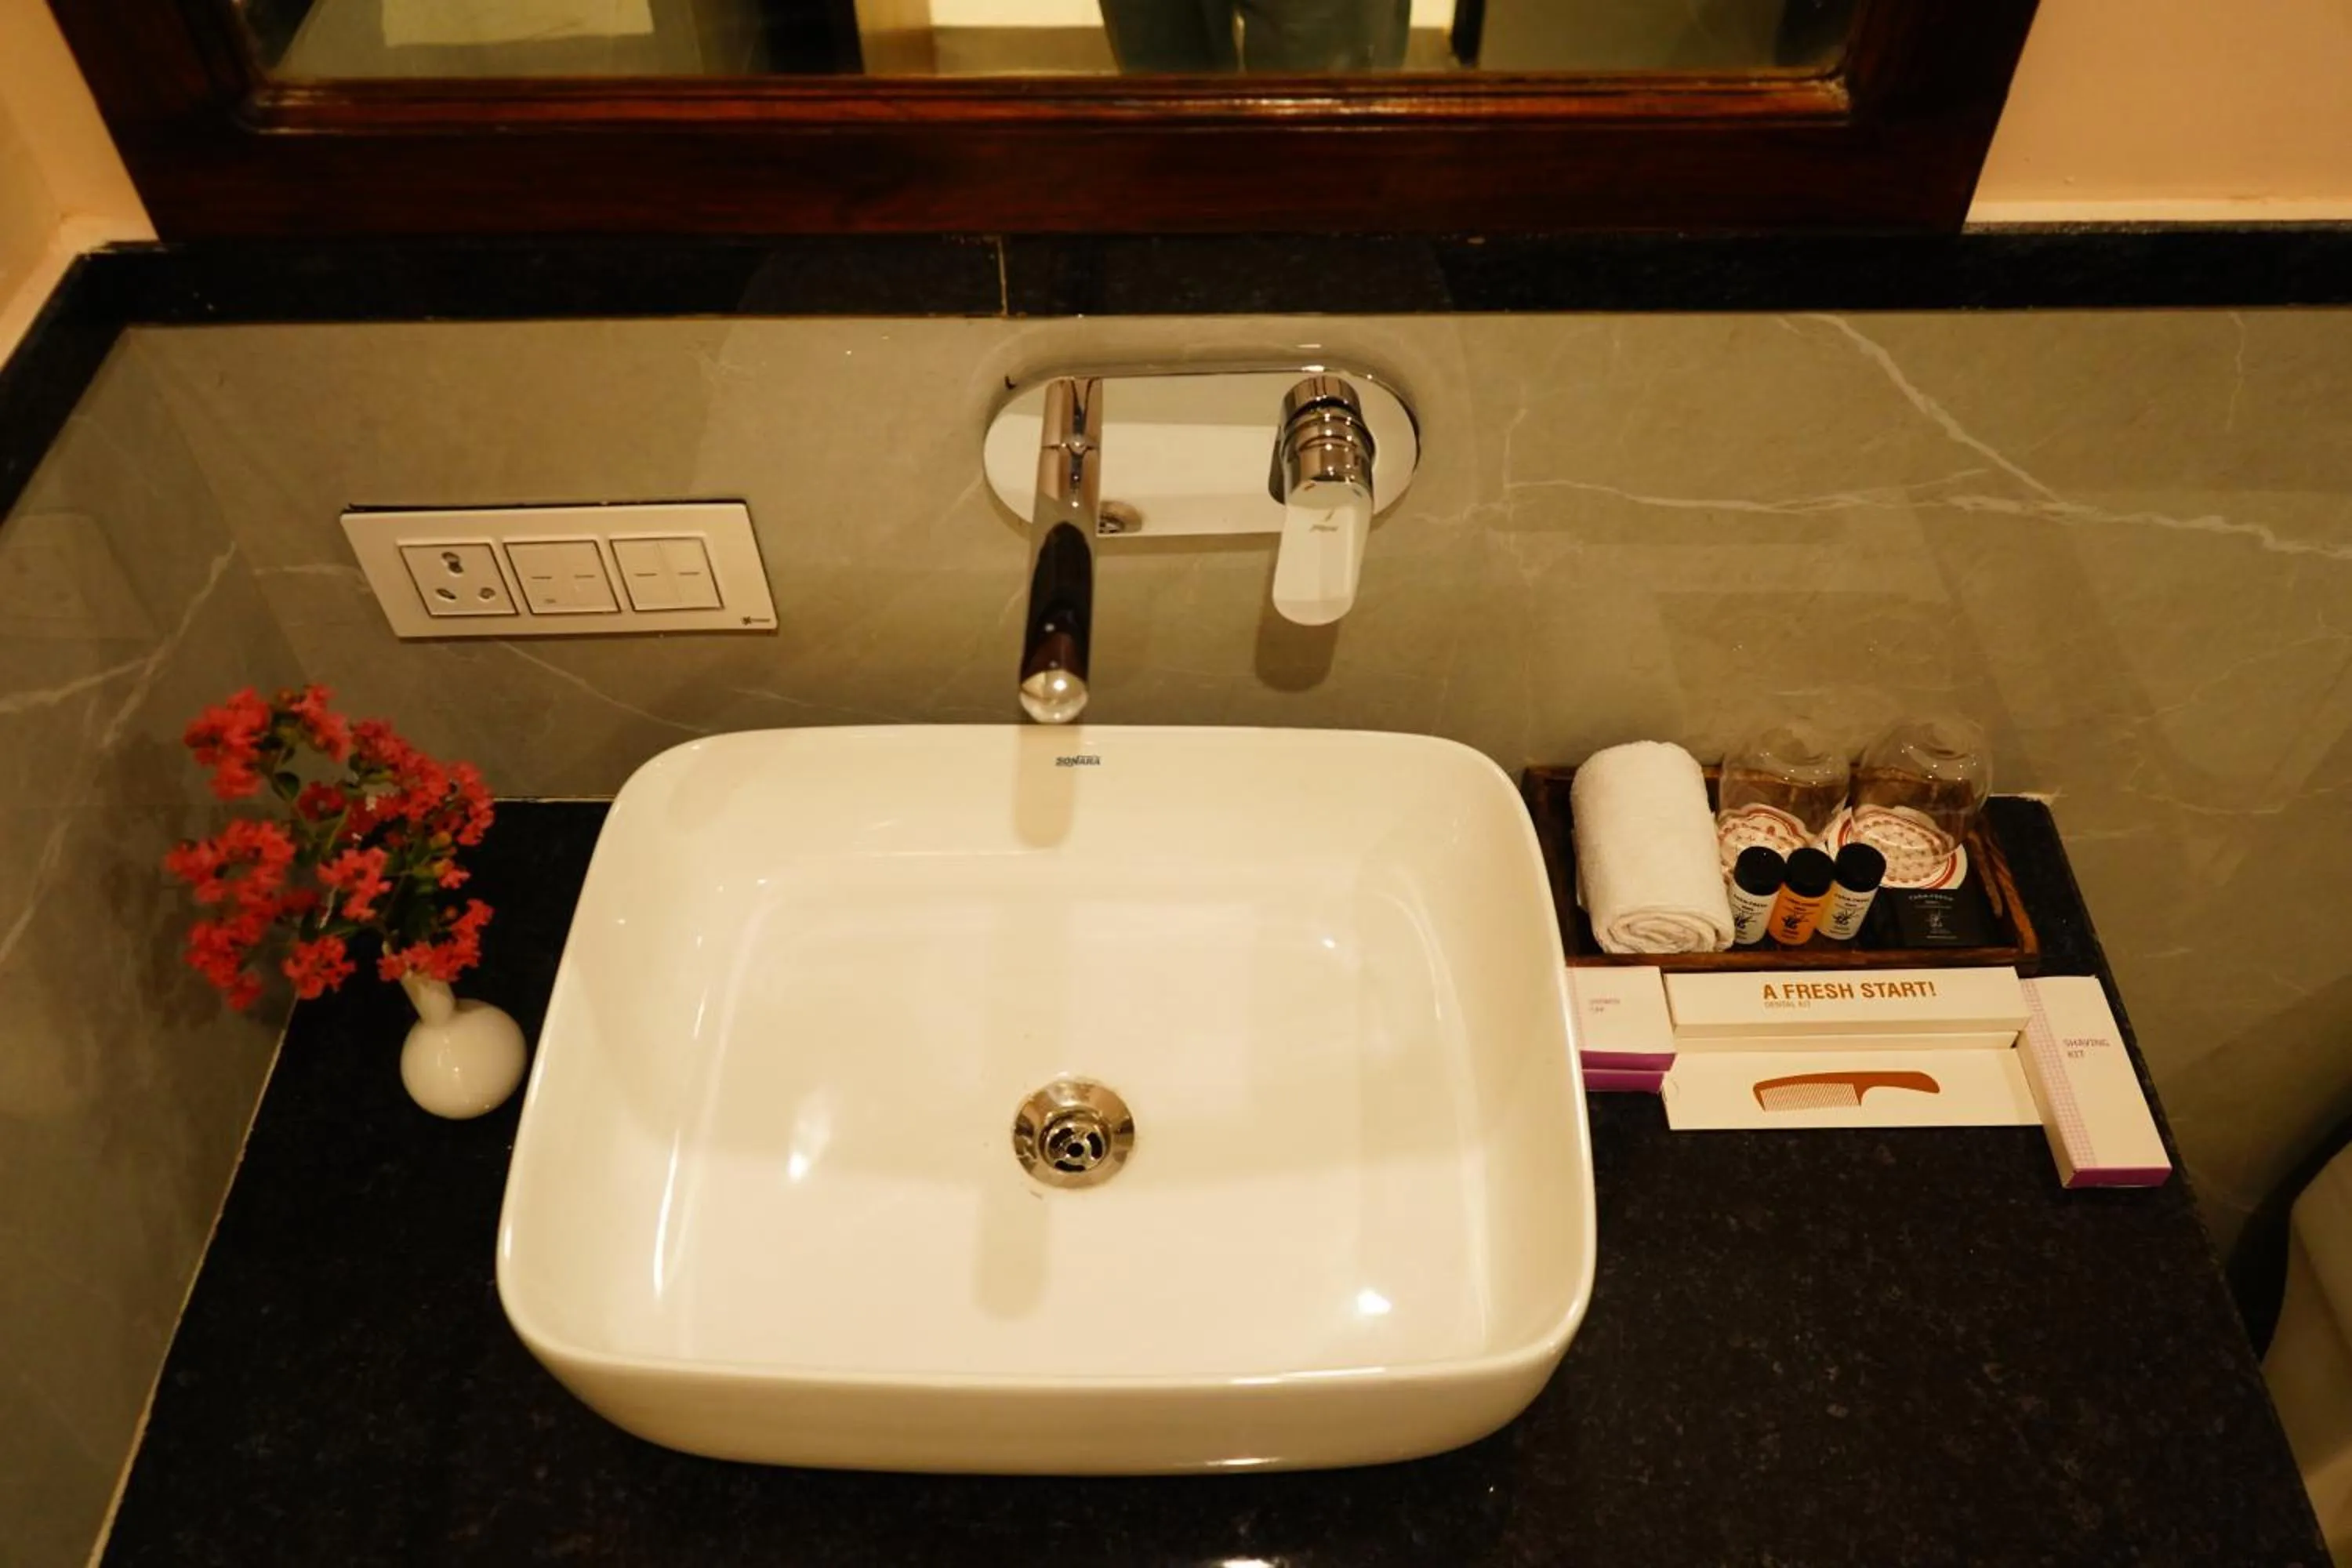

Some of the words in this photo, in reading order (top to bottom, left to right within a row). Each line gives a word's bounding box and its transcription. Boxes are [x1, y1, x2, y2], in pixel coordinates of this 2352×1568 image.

[1763, 984, 1777, 1000] A
[1782, 982, 1855, 1000] FRESH
[1860, 981, 1937, 999] START!
[2063, 1038, 2111, 1047] SHAVING
[2067, 1050, 2085, 1058] KIT
